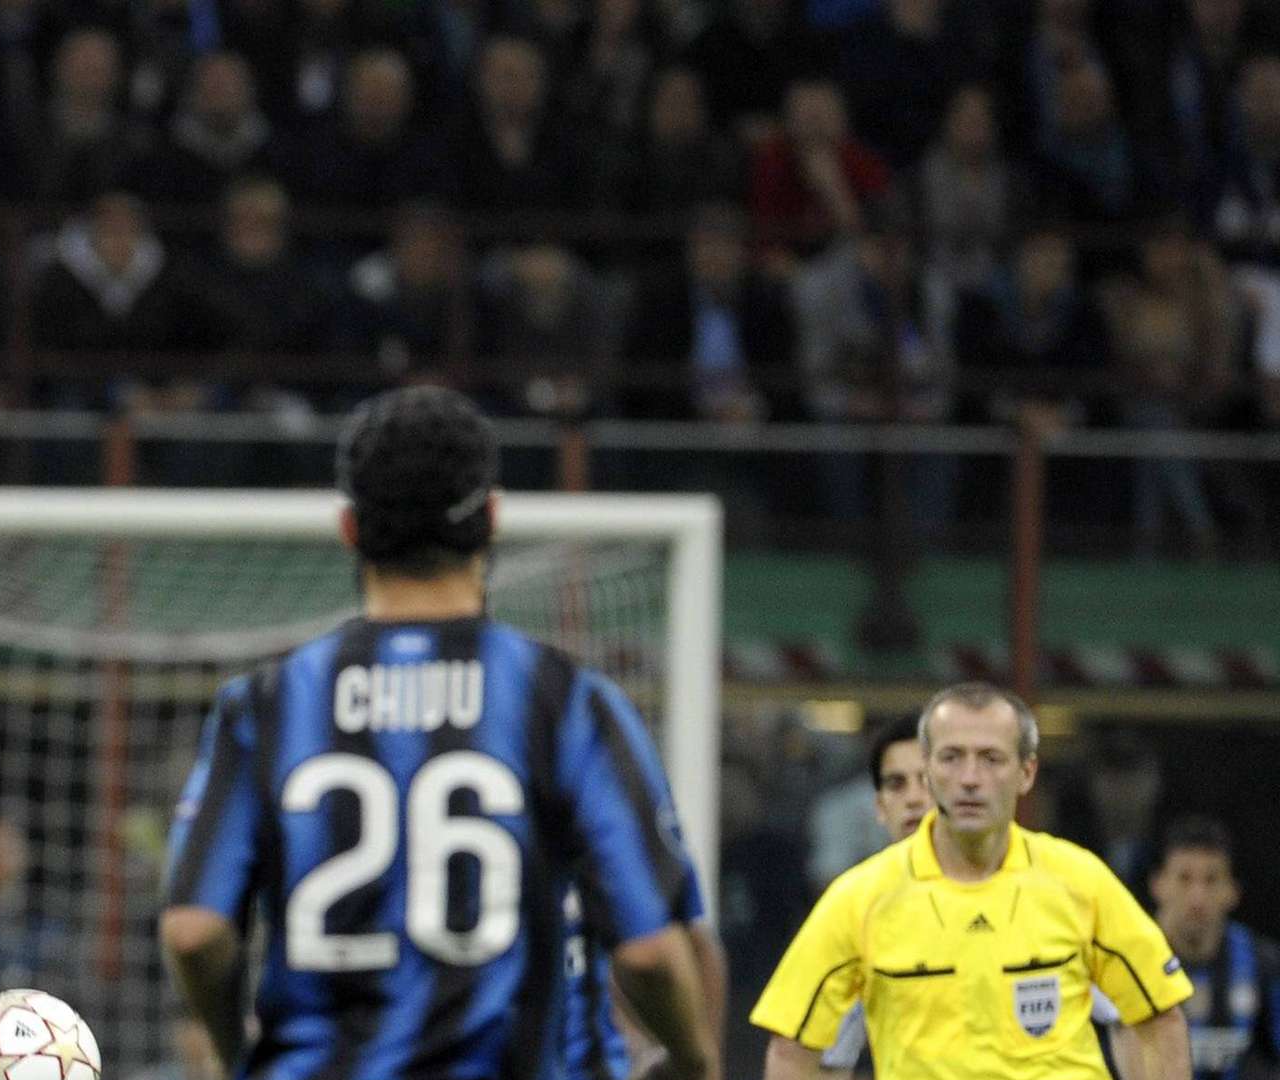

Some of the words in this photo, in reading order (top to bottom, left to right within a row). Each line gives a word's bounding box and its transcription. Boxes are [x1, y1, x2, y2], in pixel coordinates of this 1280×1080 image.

[334, 660, 484, 734] CHIVU
[281, 750, 526, 973] 26
[1020, 1000, 1055, 1014] FIFA
